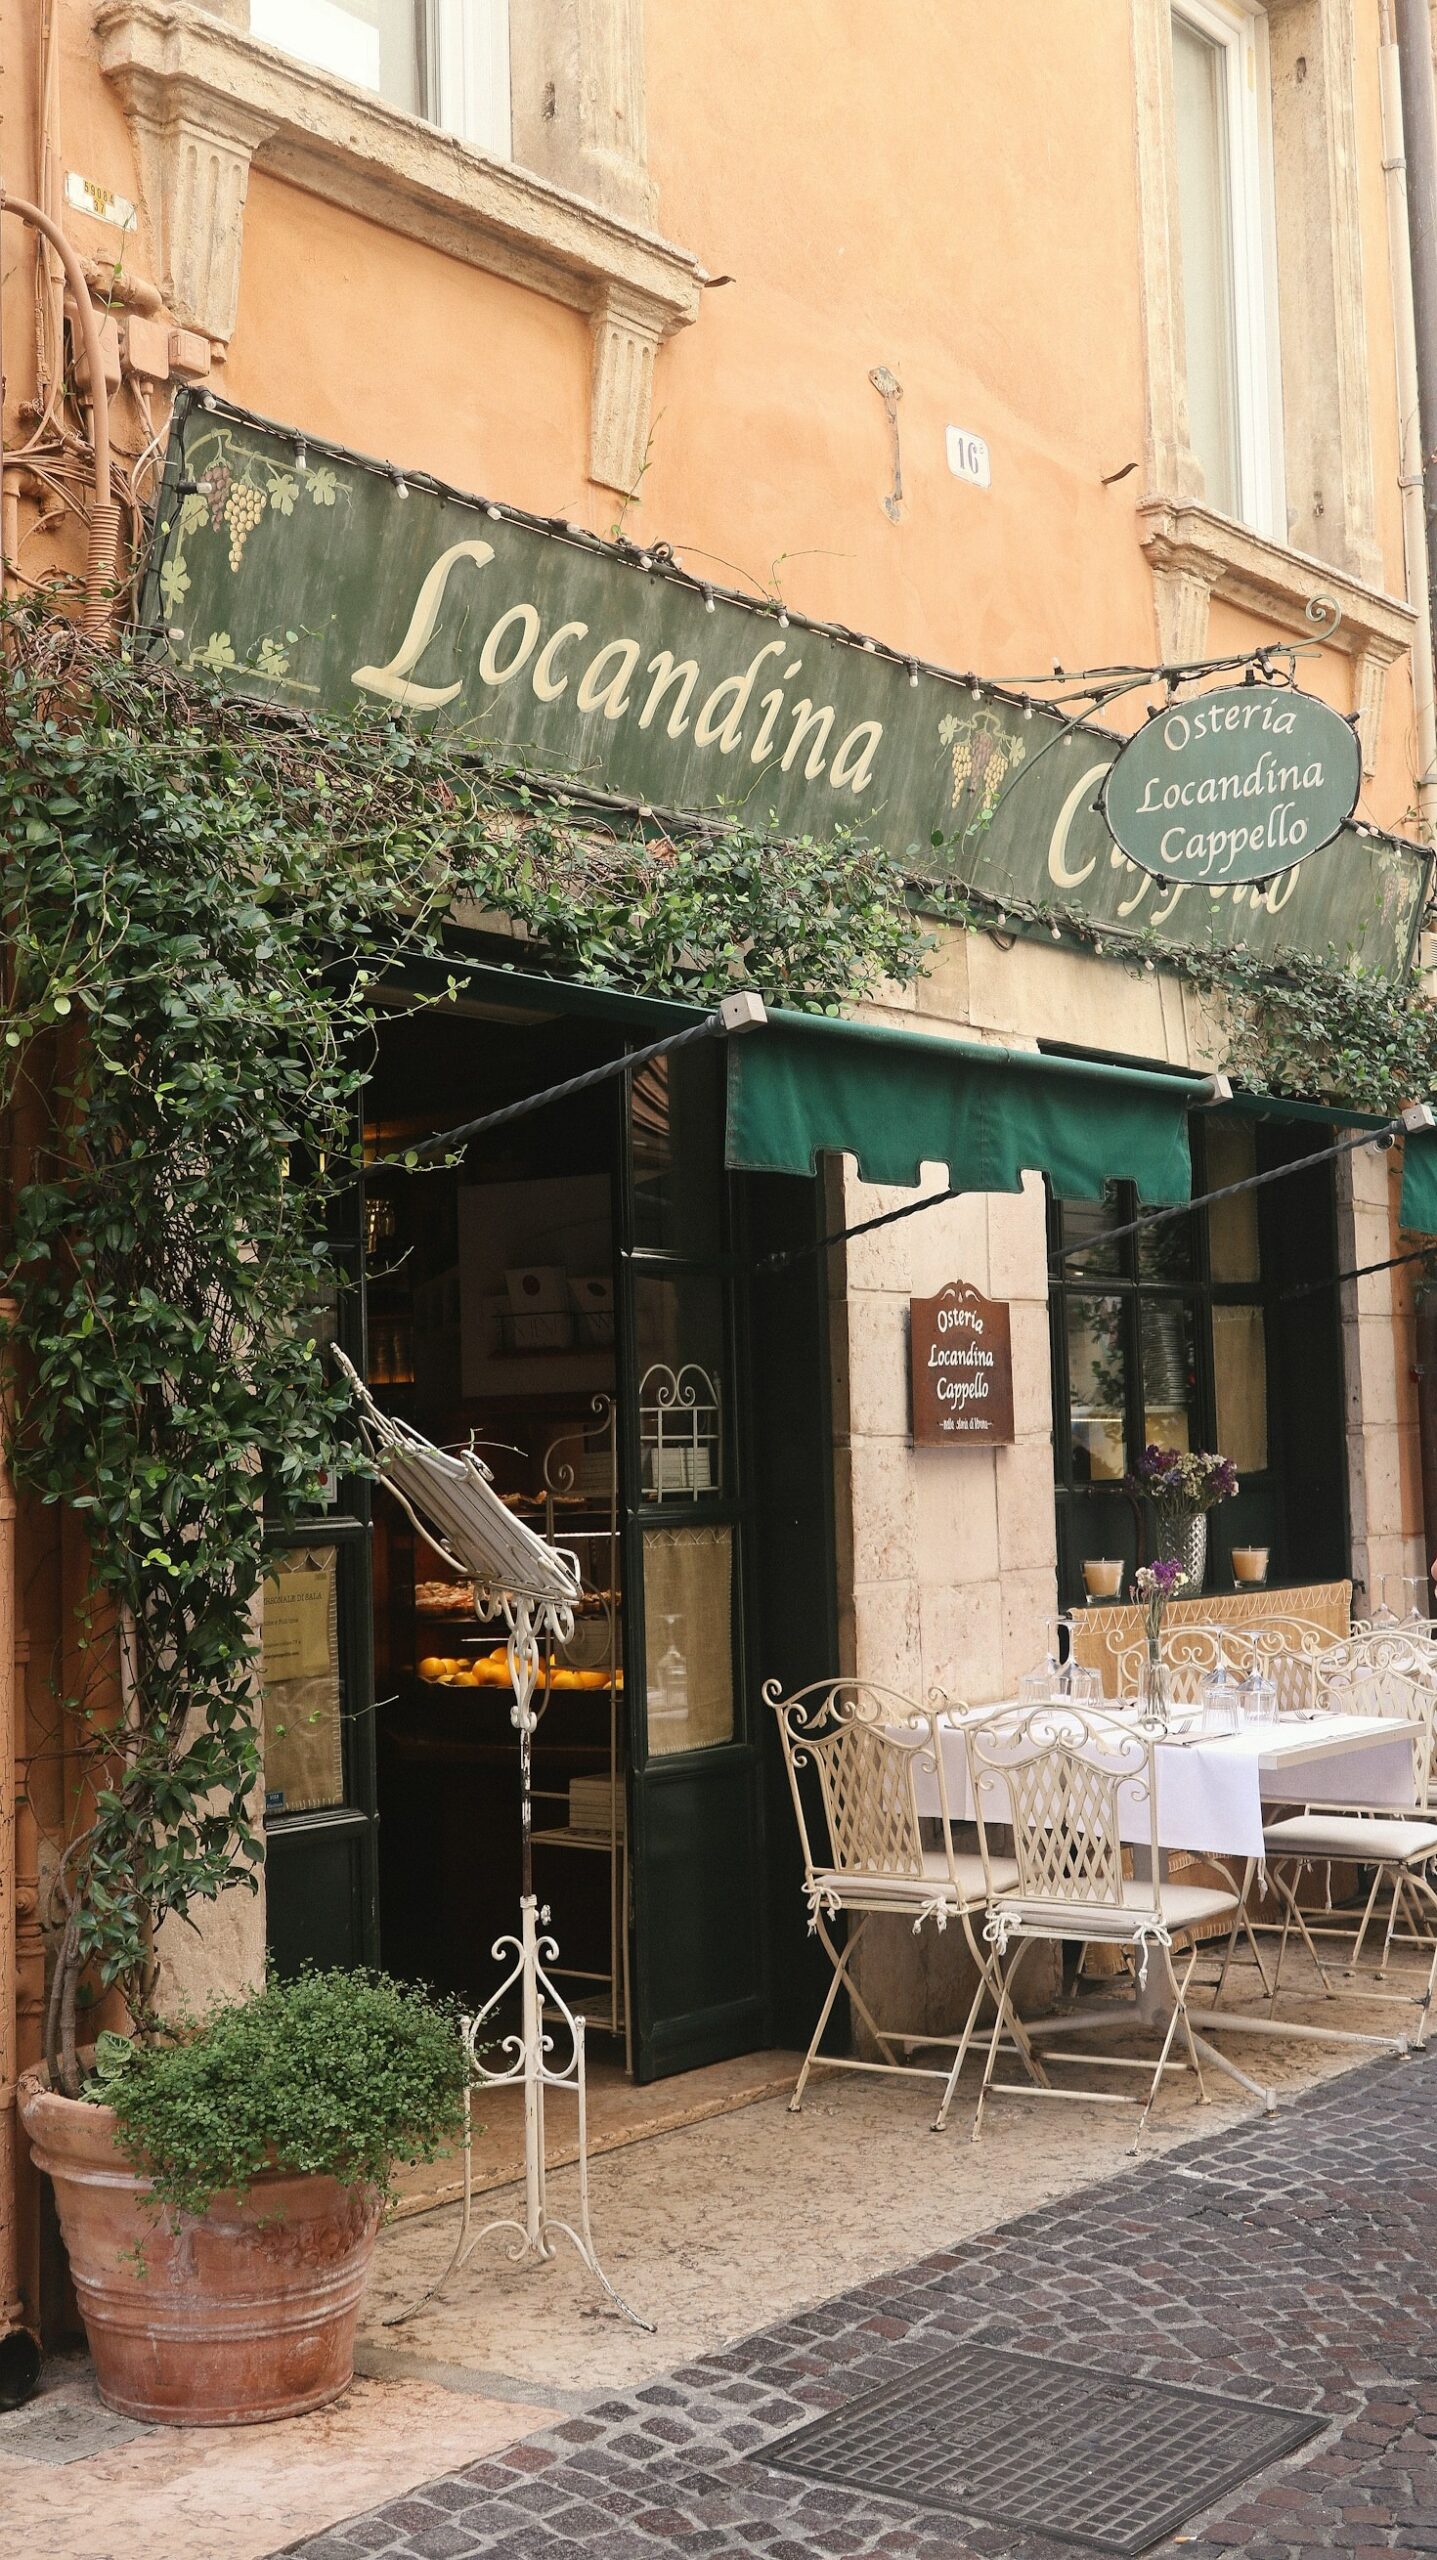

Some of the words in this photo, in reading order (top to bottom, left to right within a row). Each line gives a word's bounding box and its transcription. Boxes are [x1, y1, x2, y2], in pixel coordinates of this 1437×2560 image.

[350, 539, 884, 794] Locandina
[1163, 697, 1297, 751] Osteria
[1135, 751, 1325, 813] Locandina
[1160, 801, 1308, 876] Cappello
[937, 1307, 984, 1334] Osteria
[927, 1341, 994, 1367] Locandina
[936, 1372, 989, 1410] Cappello
